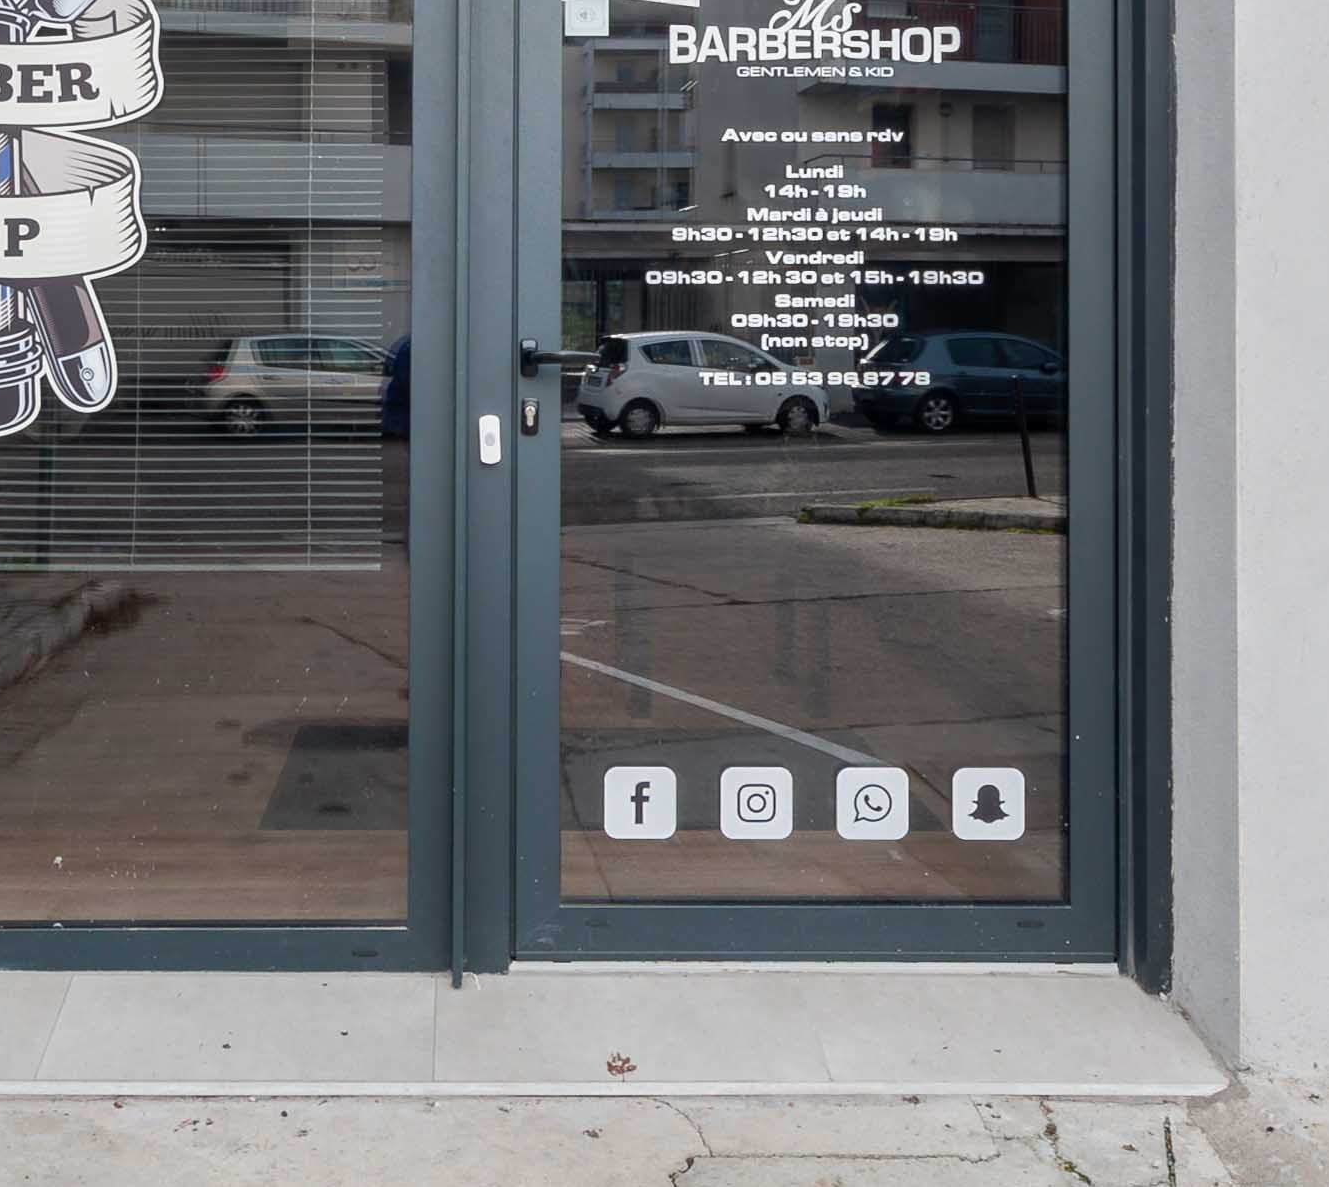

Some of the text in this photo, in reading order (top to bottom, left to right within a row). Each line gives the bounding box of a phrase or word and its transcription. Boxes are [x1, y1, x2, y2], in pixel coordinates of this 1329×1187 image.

[669, 24, 962, 64] BARBERSHOP
[736, 66, 895, 78] GENTLEMEN & KID
[721, 128, 904, 143] Avec ou sans rdv
[785, 164, 844, 179] Lundi
[764, 184, 808, 199] 14h
[823, 184, 867, 199] 19h
[747, 207, 883, 224] Mardi à jeudi
[672, 227, 733, 241] 9h30
[747, 227, 824, 241] 12h30
[826, 228, 851, 241] et
[855, 227, 899, 242] 14h
[914, 227, 958, 242] 19h
[765, 250, 864, 265] Vendredi
[645, 270, 723, 285] 09h30
[737, 270, 782, 285] 12h
[785, 270, 818, 285] 30
[820, 272, 845, 285] et
[849, 270, 894, 285] 15h
[908, 270, 984, 285] 19h30
[774, 293, 855, 308] Samedi
[731, 313, 809, 328] 09h30
[823, 313, 899, 328] 19h30
[761, 333, 869, 351] (non stop)
[755, 371, 787, 386] 05
[791, 371, 824, 386] 53
[899, 371, 931, 386] 78
